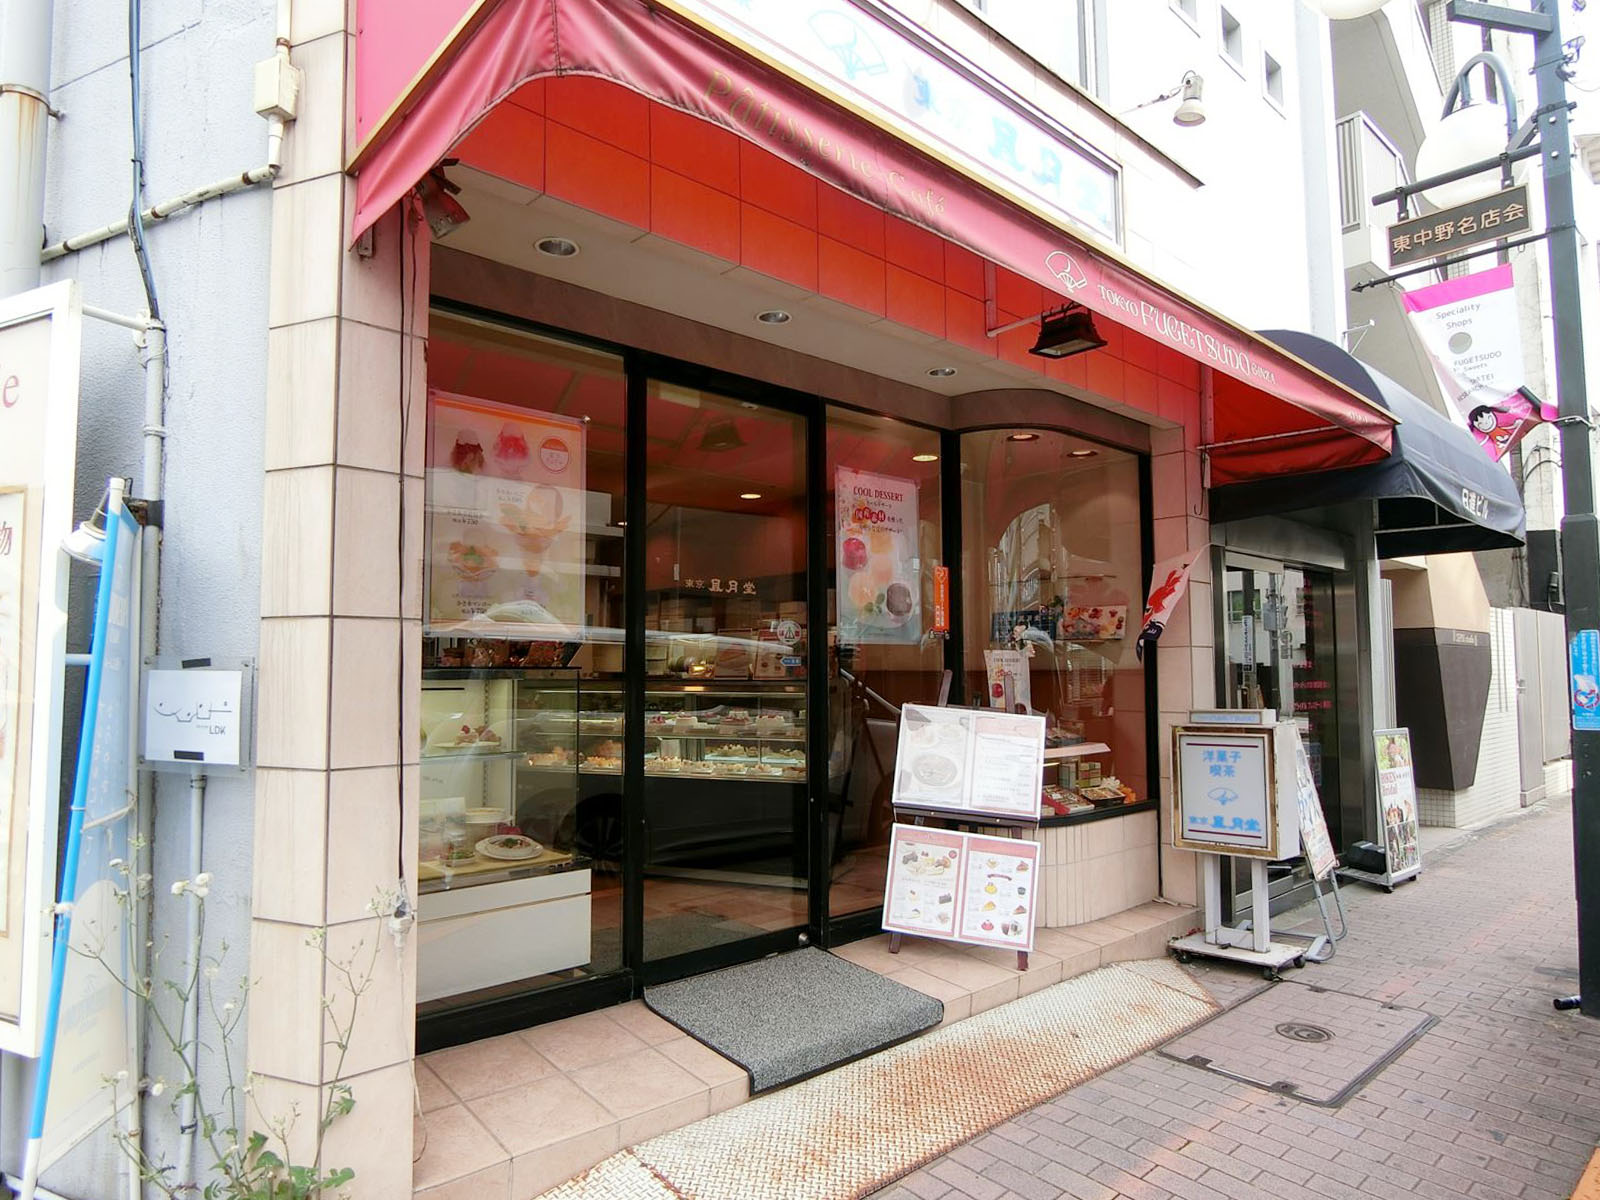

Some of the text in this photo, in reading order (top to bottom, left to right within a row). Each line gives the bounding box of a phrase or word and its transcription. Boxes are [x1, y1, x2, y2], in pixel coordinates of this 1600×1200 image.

[1392, 202, 1525, 255] 東中野名店会
[1435, 303, 1481, 320] Speciality
[1446, 318, 1473, 330] Shops
[1097, 284, 1276, 385] TOKYO FUGETSUDO GINZA
[853, 486, 904, 502] COOL DESSERT
[1202, 749, 1242, 763] 洋菓子
[1209, 764, 1235, 778] 喫茶
